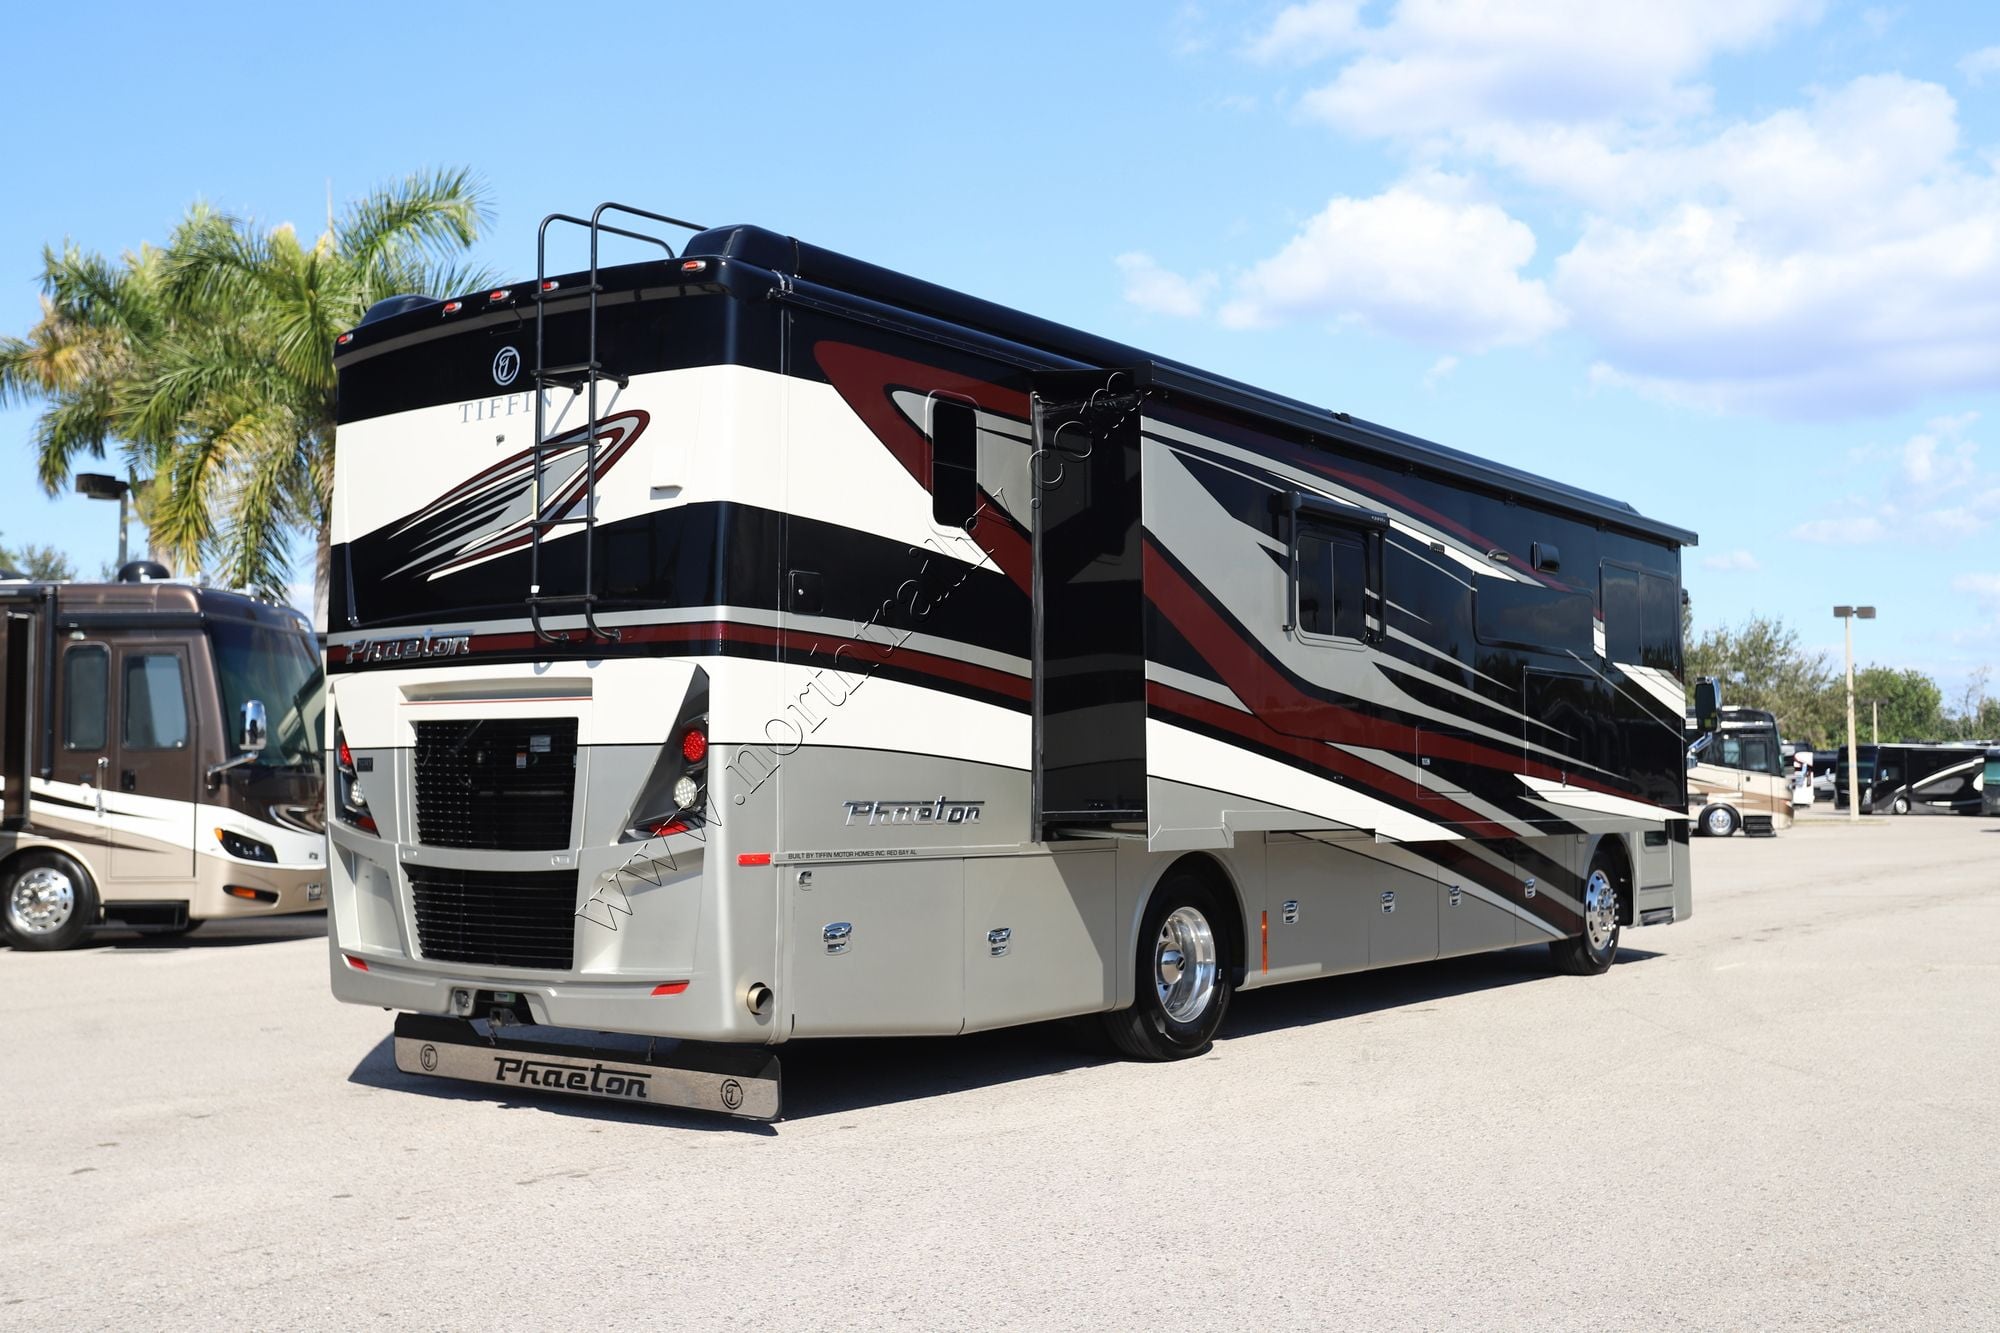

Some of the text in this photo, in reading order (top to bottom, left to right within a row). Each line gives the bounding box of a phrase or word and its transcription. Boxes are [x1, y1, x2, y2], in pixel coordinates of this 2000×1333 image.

[344, 628, 474, 664] Phaeton
[842, 795, 985, 826] Phaeton
[815, 851, 833, 859] TIFFIN
[494, 1057, 652, 1098] Phaeton
